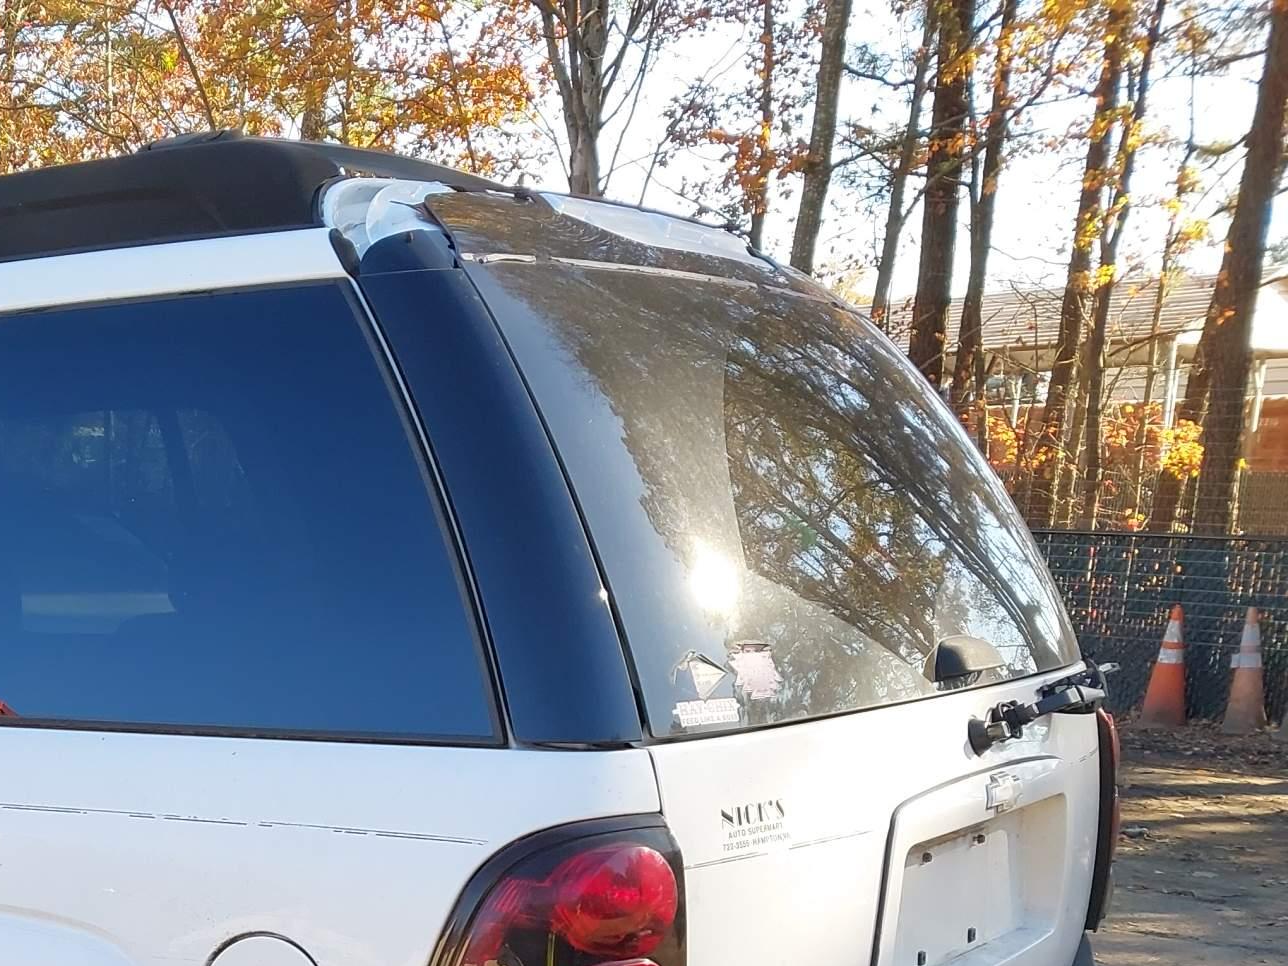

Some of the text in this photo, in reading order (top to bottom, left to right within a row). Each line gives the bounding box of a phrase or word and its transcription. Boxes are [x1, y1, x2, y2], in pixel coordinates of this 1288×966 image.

[720, 798, 785, 830] NICK'S
[728, 822, 783, 839] AUTO SUPERMART
